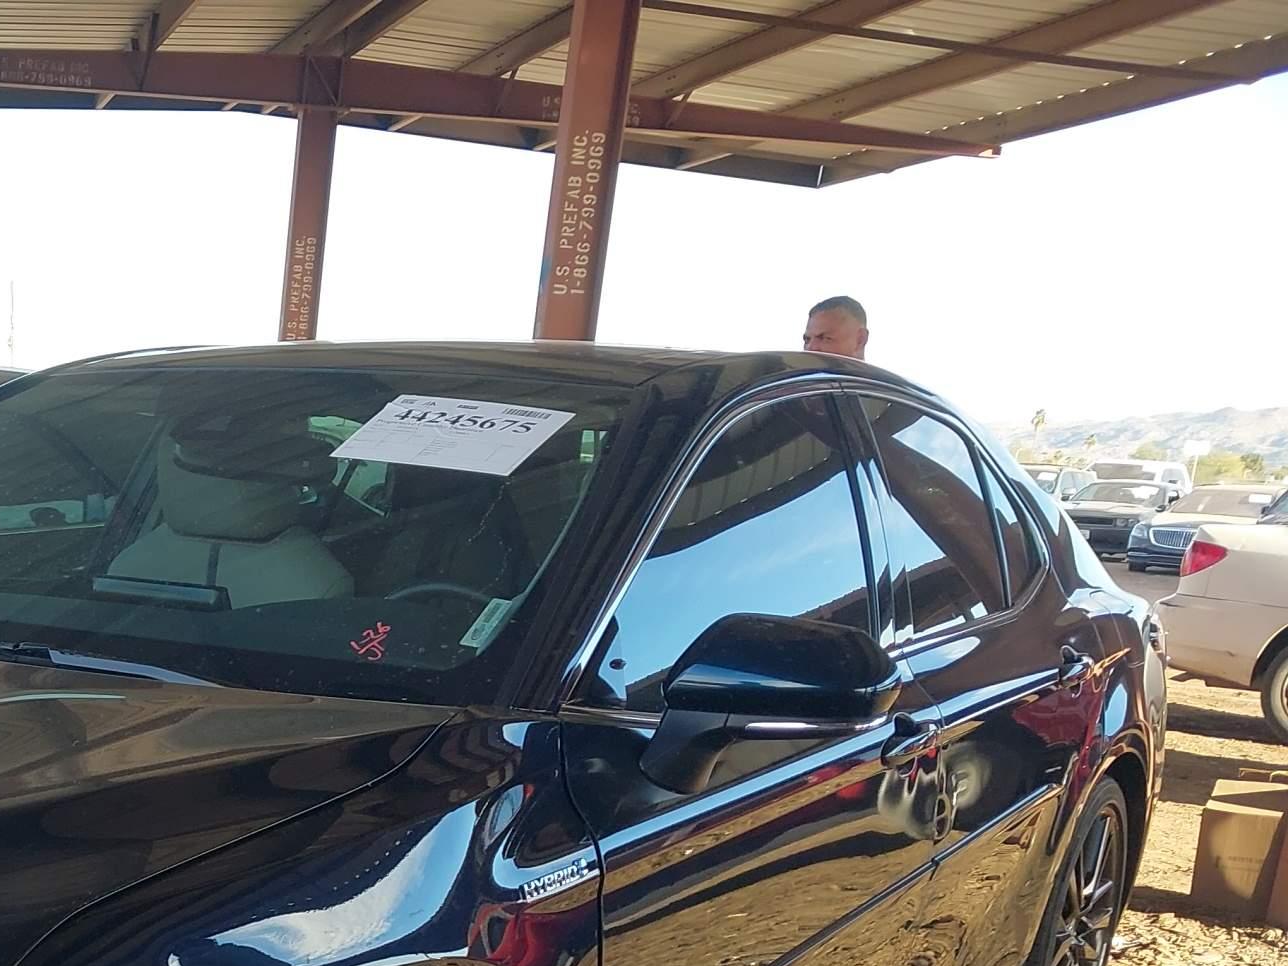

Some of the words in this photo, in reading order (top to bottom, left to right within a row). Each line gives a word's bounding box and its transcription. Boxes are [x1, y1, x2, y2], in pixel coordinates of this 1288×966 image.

[570, 128, 590, 166] INC.
[559, 175, 583, 250] PREFAB
[570, 131, 607, 295] 1-866-799-0969
[295, 235, 306, 259] INC.
[290, 264, 303, 312] PREFAB
[552, 260, 571, 296] U.S.
[393, 408, 538, 435] 44245675
[523, 865, 581, 899] HYBRID
